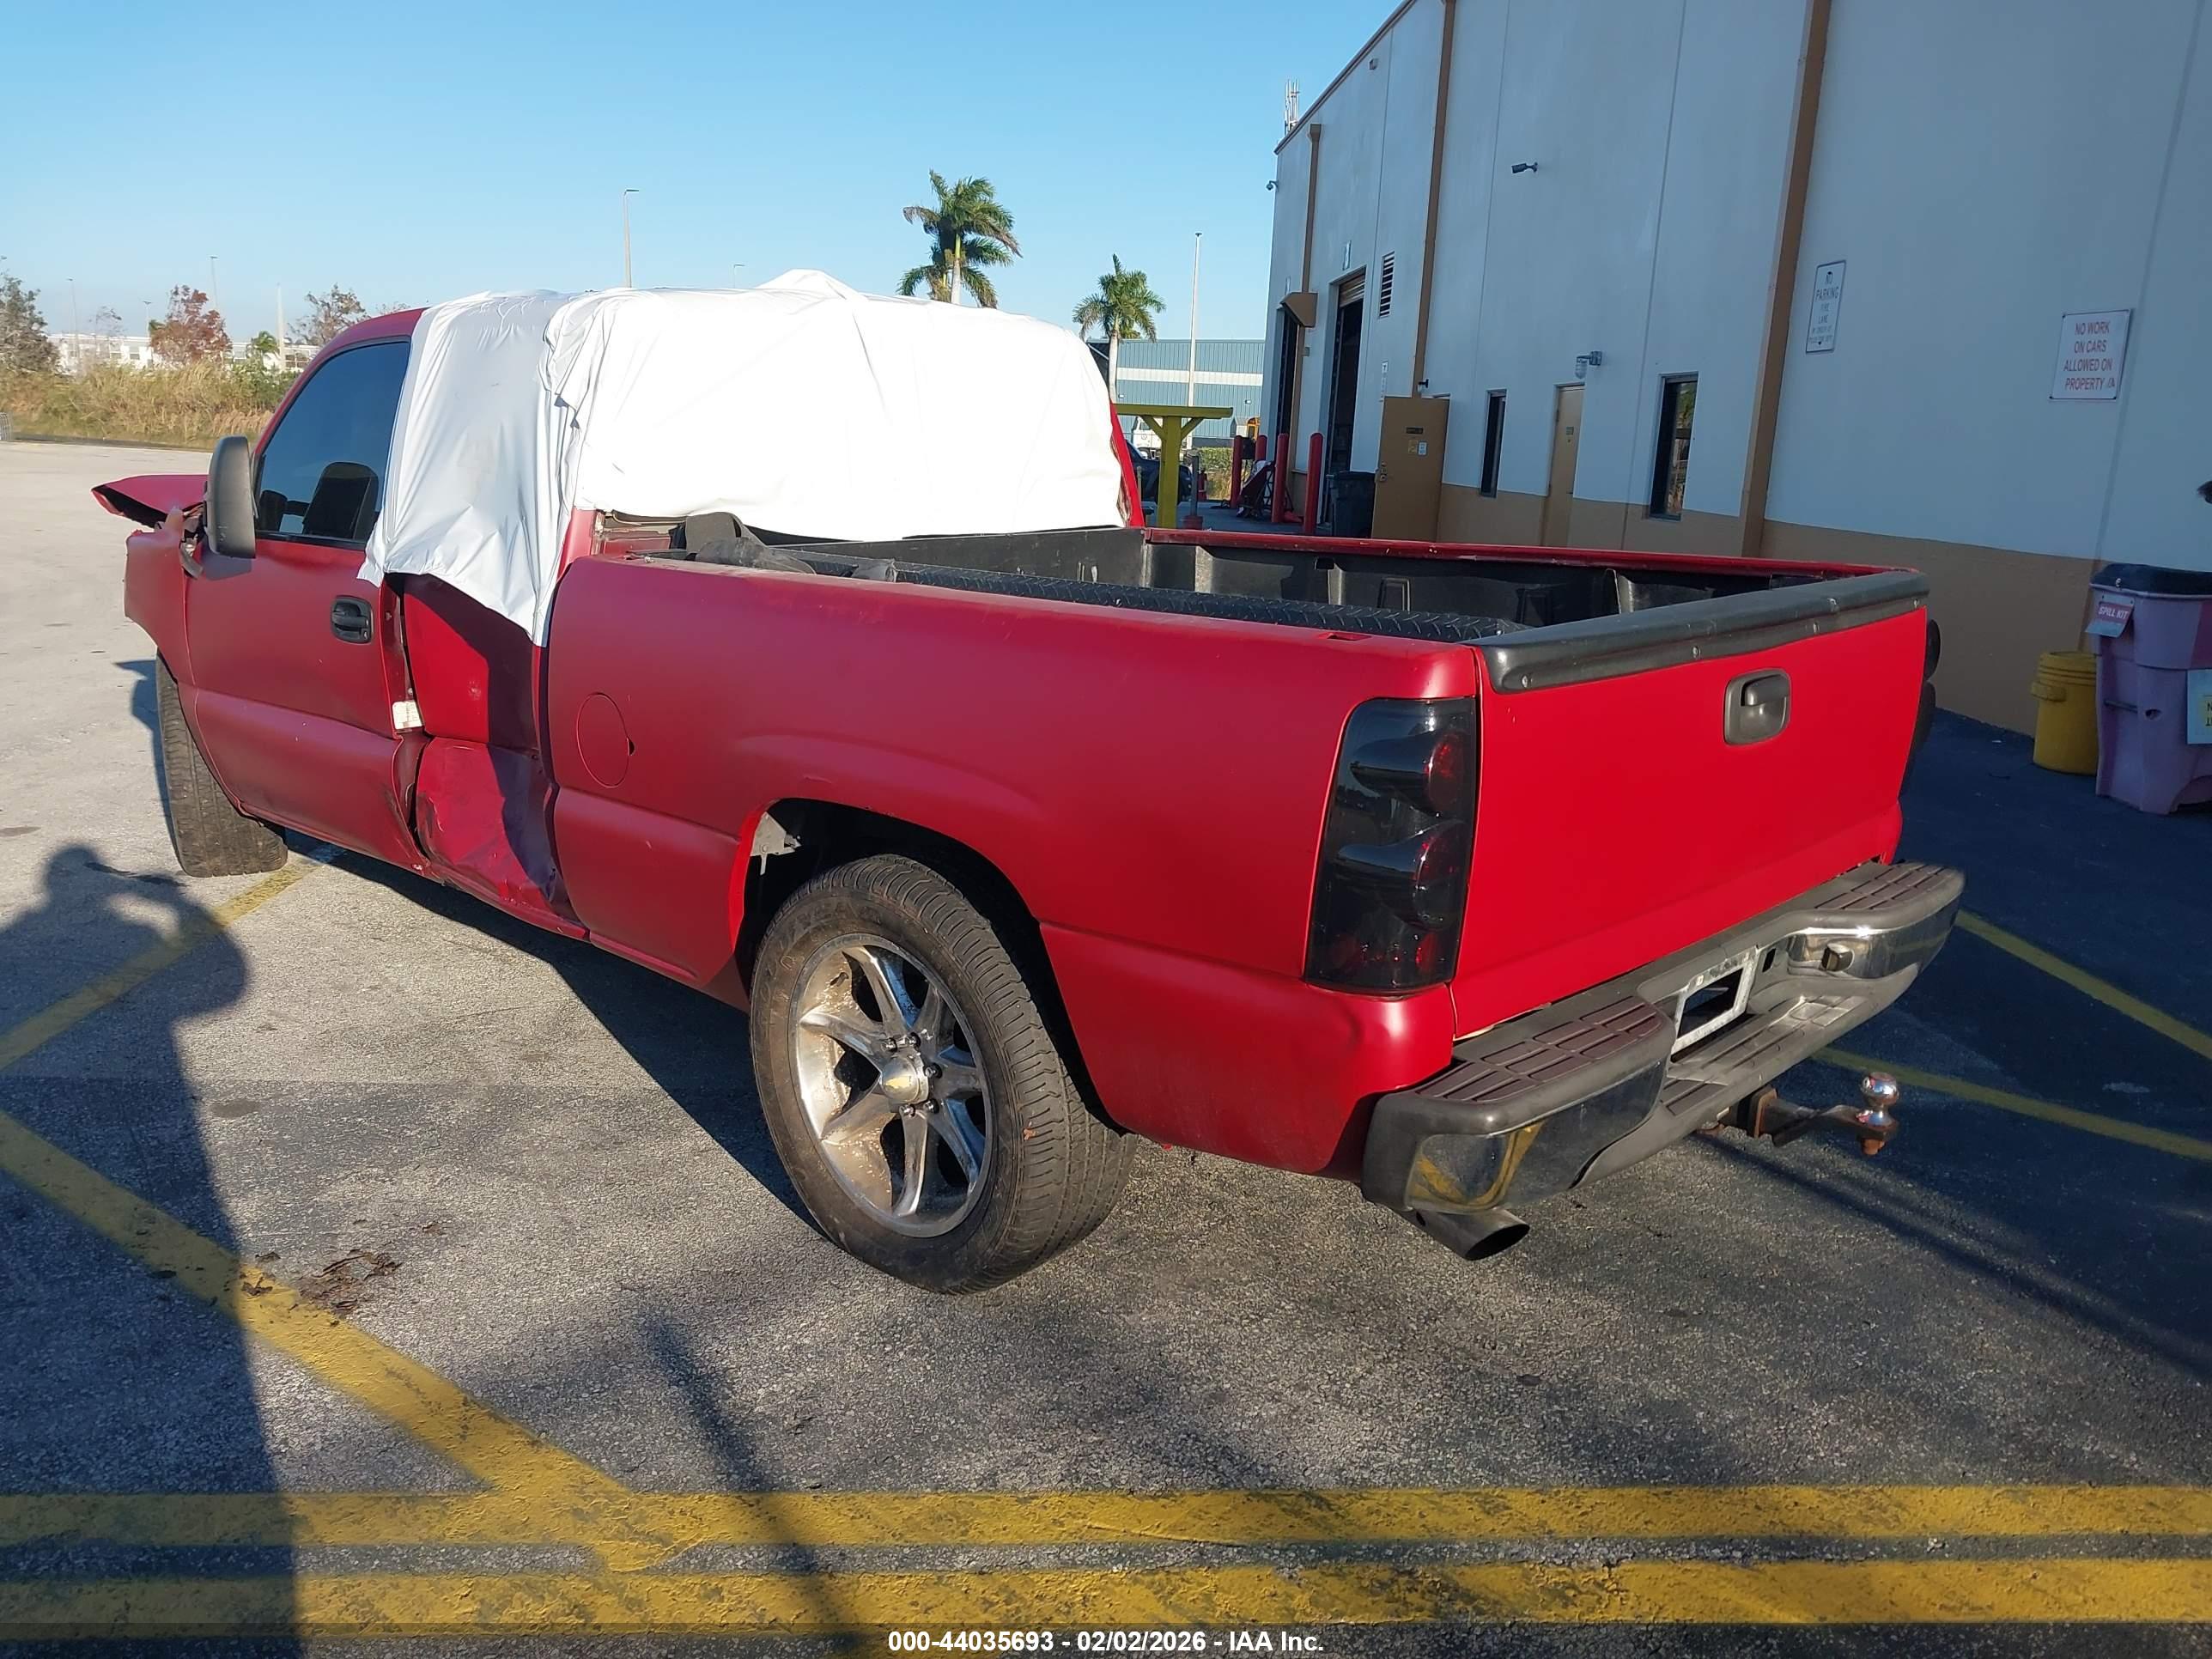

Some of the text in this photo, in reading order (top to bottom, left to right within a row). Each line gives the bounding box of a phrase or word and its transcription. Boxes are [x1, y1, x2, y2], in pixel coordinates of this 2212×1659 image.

[1816, 286, 1839, 301] PARKING
[2075, 321, 2111, 335] NO WORK
[2074, 339, 2107, 354] ON CARS
[2063, 358, 2113, 372] ALLOWED ON
[2065, 377, 2105, 391] PROPERTY
[2098, 606, 2115, 617] SPILL
